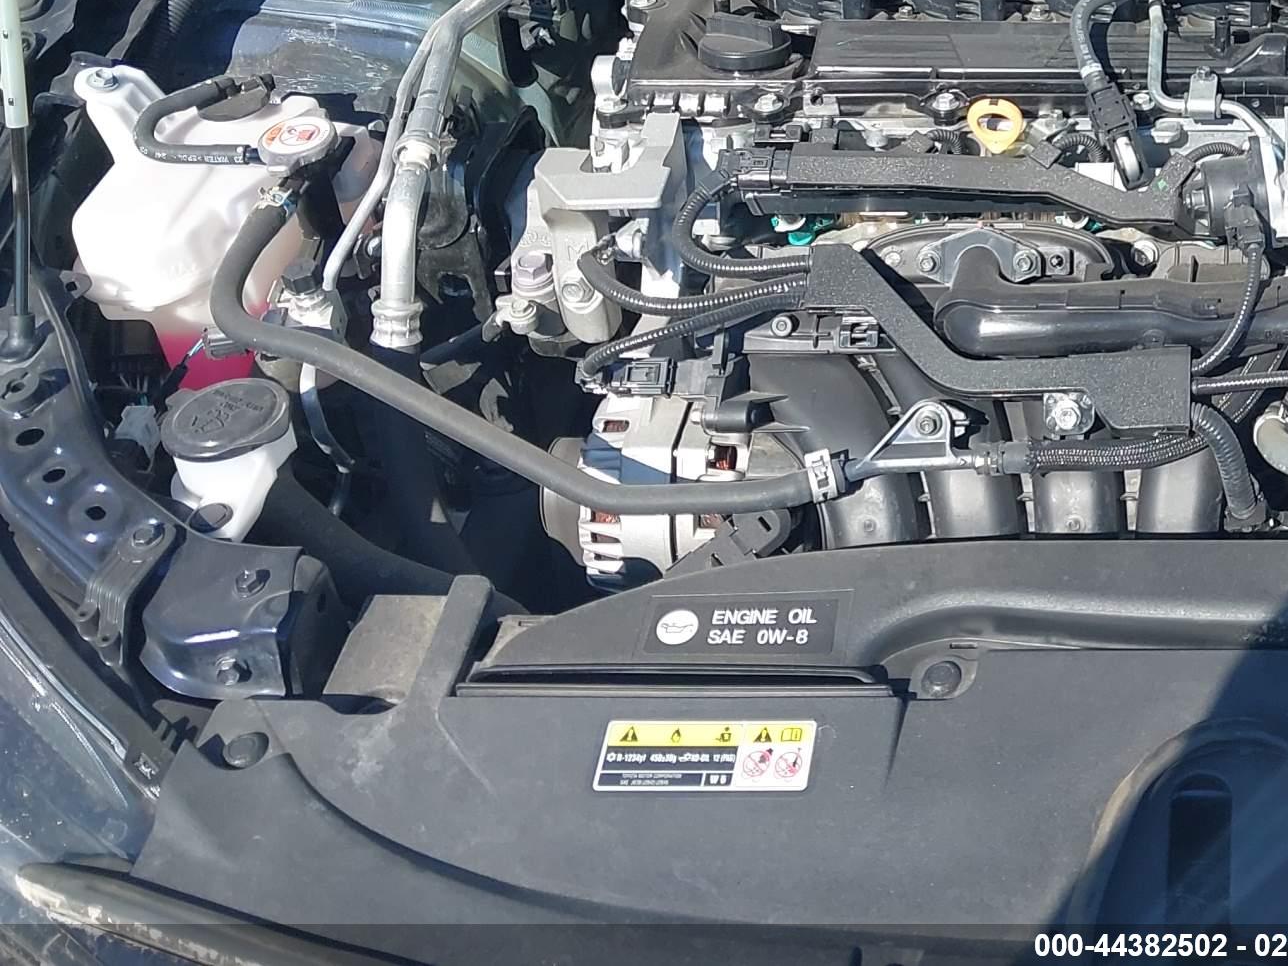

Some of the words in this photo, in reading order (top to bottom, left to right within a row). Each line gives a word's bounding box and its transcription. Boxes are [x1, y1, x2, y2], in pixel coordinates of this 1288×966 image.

[204, 155, 230, 164] WATER
[711, 608, 777, 625] ENGINE
[787, 607, 818, 624] OIL
[707, 629, 745, 645] SAE
[756, 629, 809, 645] 0W-8
